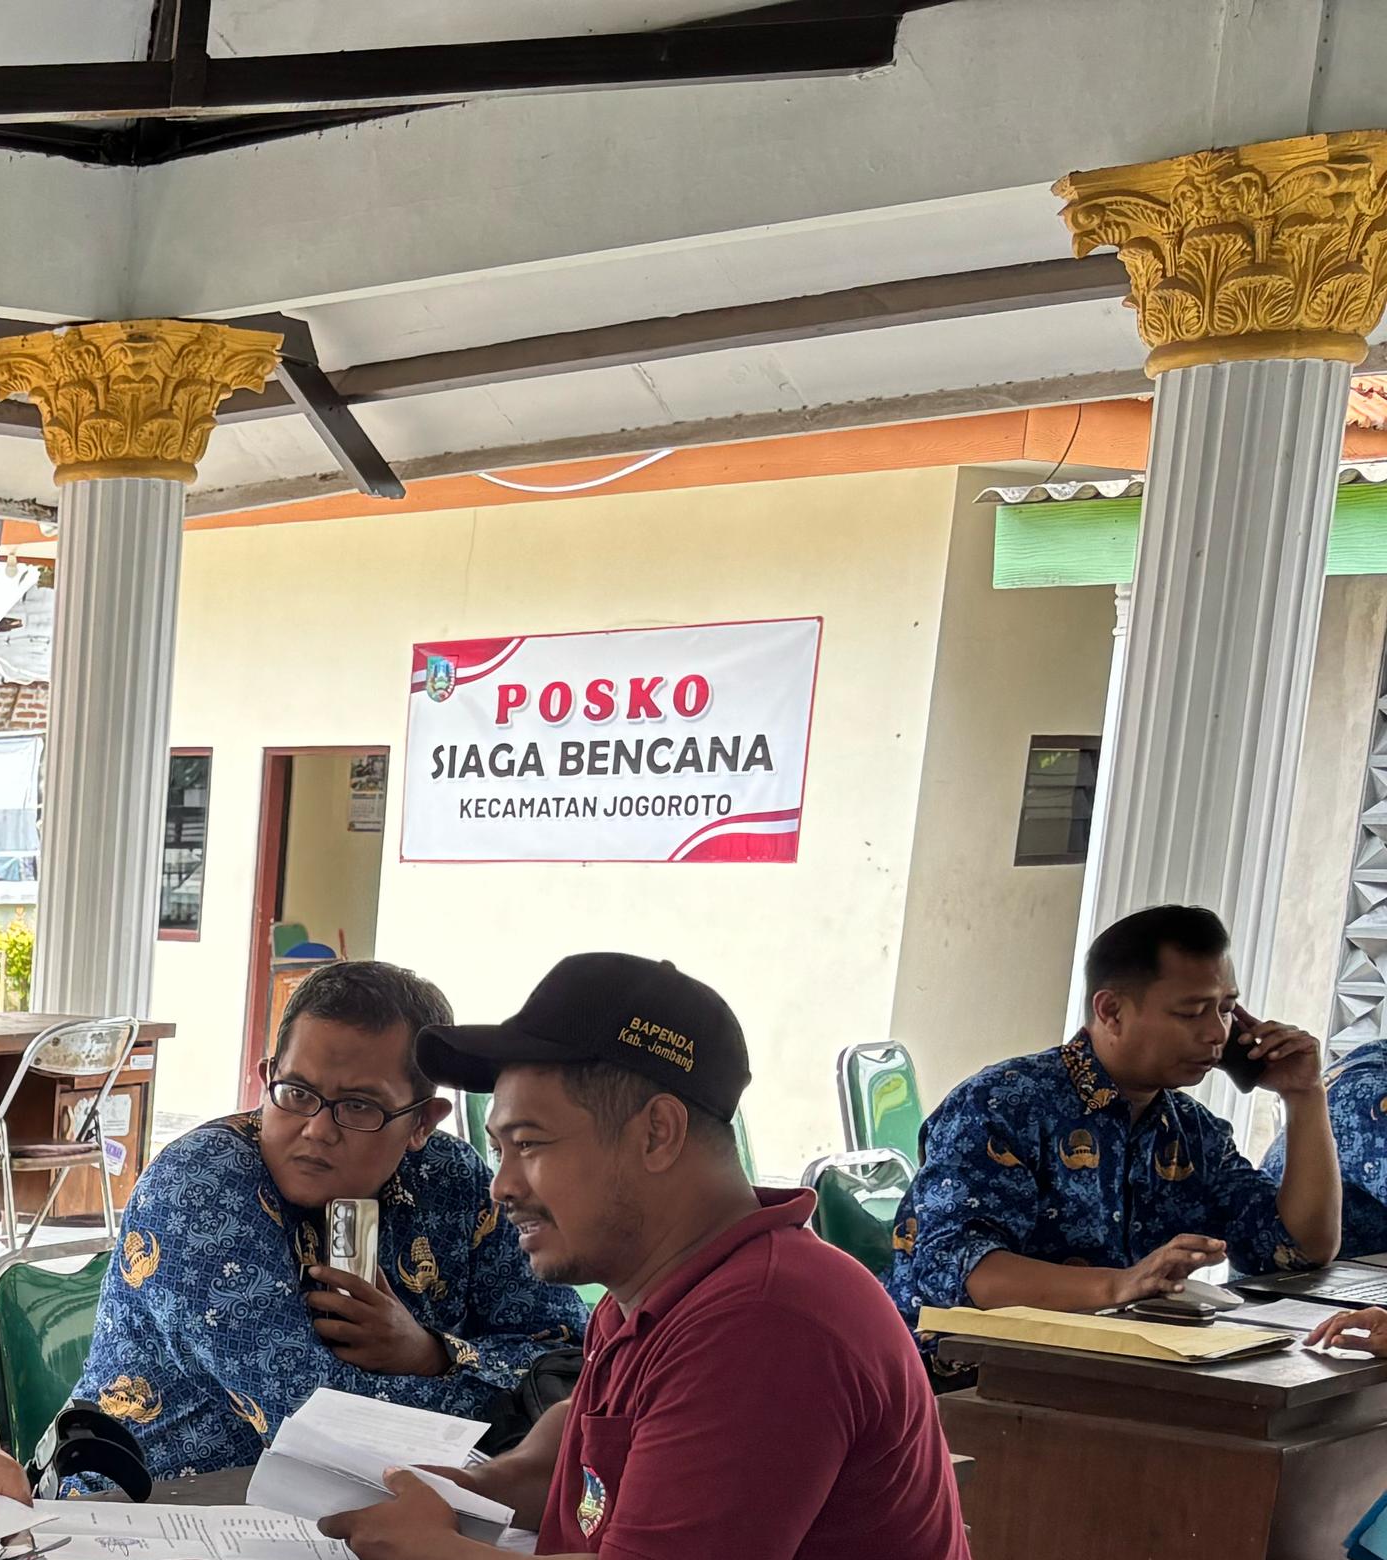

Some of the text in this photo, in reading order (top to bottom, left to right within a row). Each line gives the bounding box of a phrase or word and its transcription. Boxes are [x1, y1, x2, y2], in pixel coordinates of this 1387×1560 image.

[495, 673, 712, 725] POSKO
[430, 733, 774, 780] SIAGA BENCANA
[459, 793, 732, 819] KECAMATAN JOGOROTO
[617, 1027, 694, 1072] Kab. Jombang
[630, 1017, 694, 1054] BAPENDA
